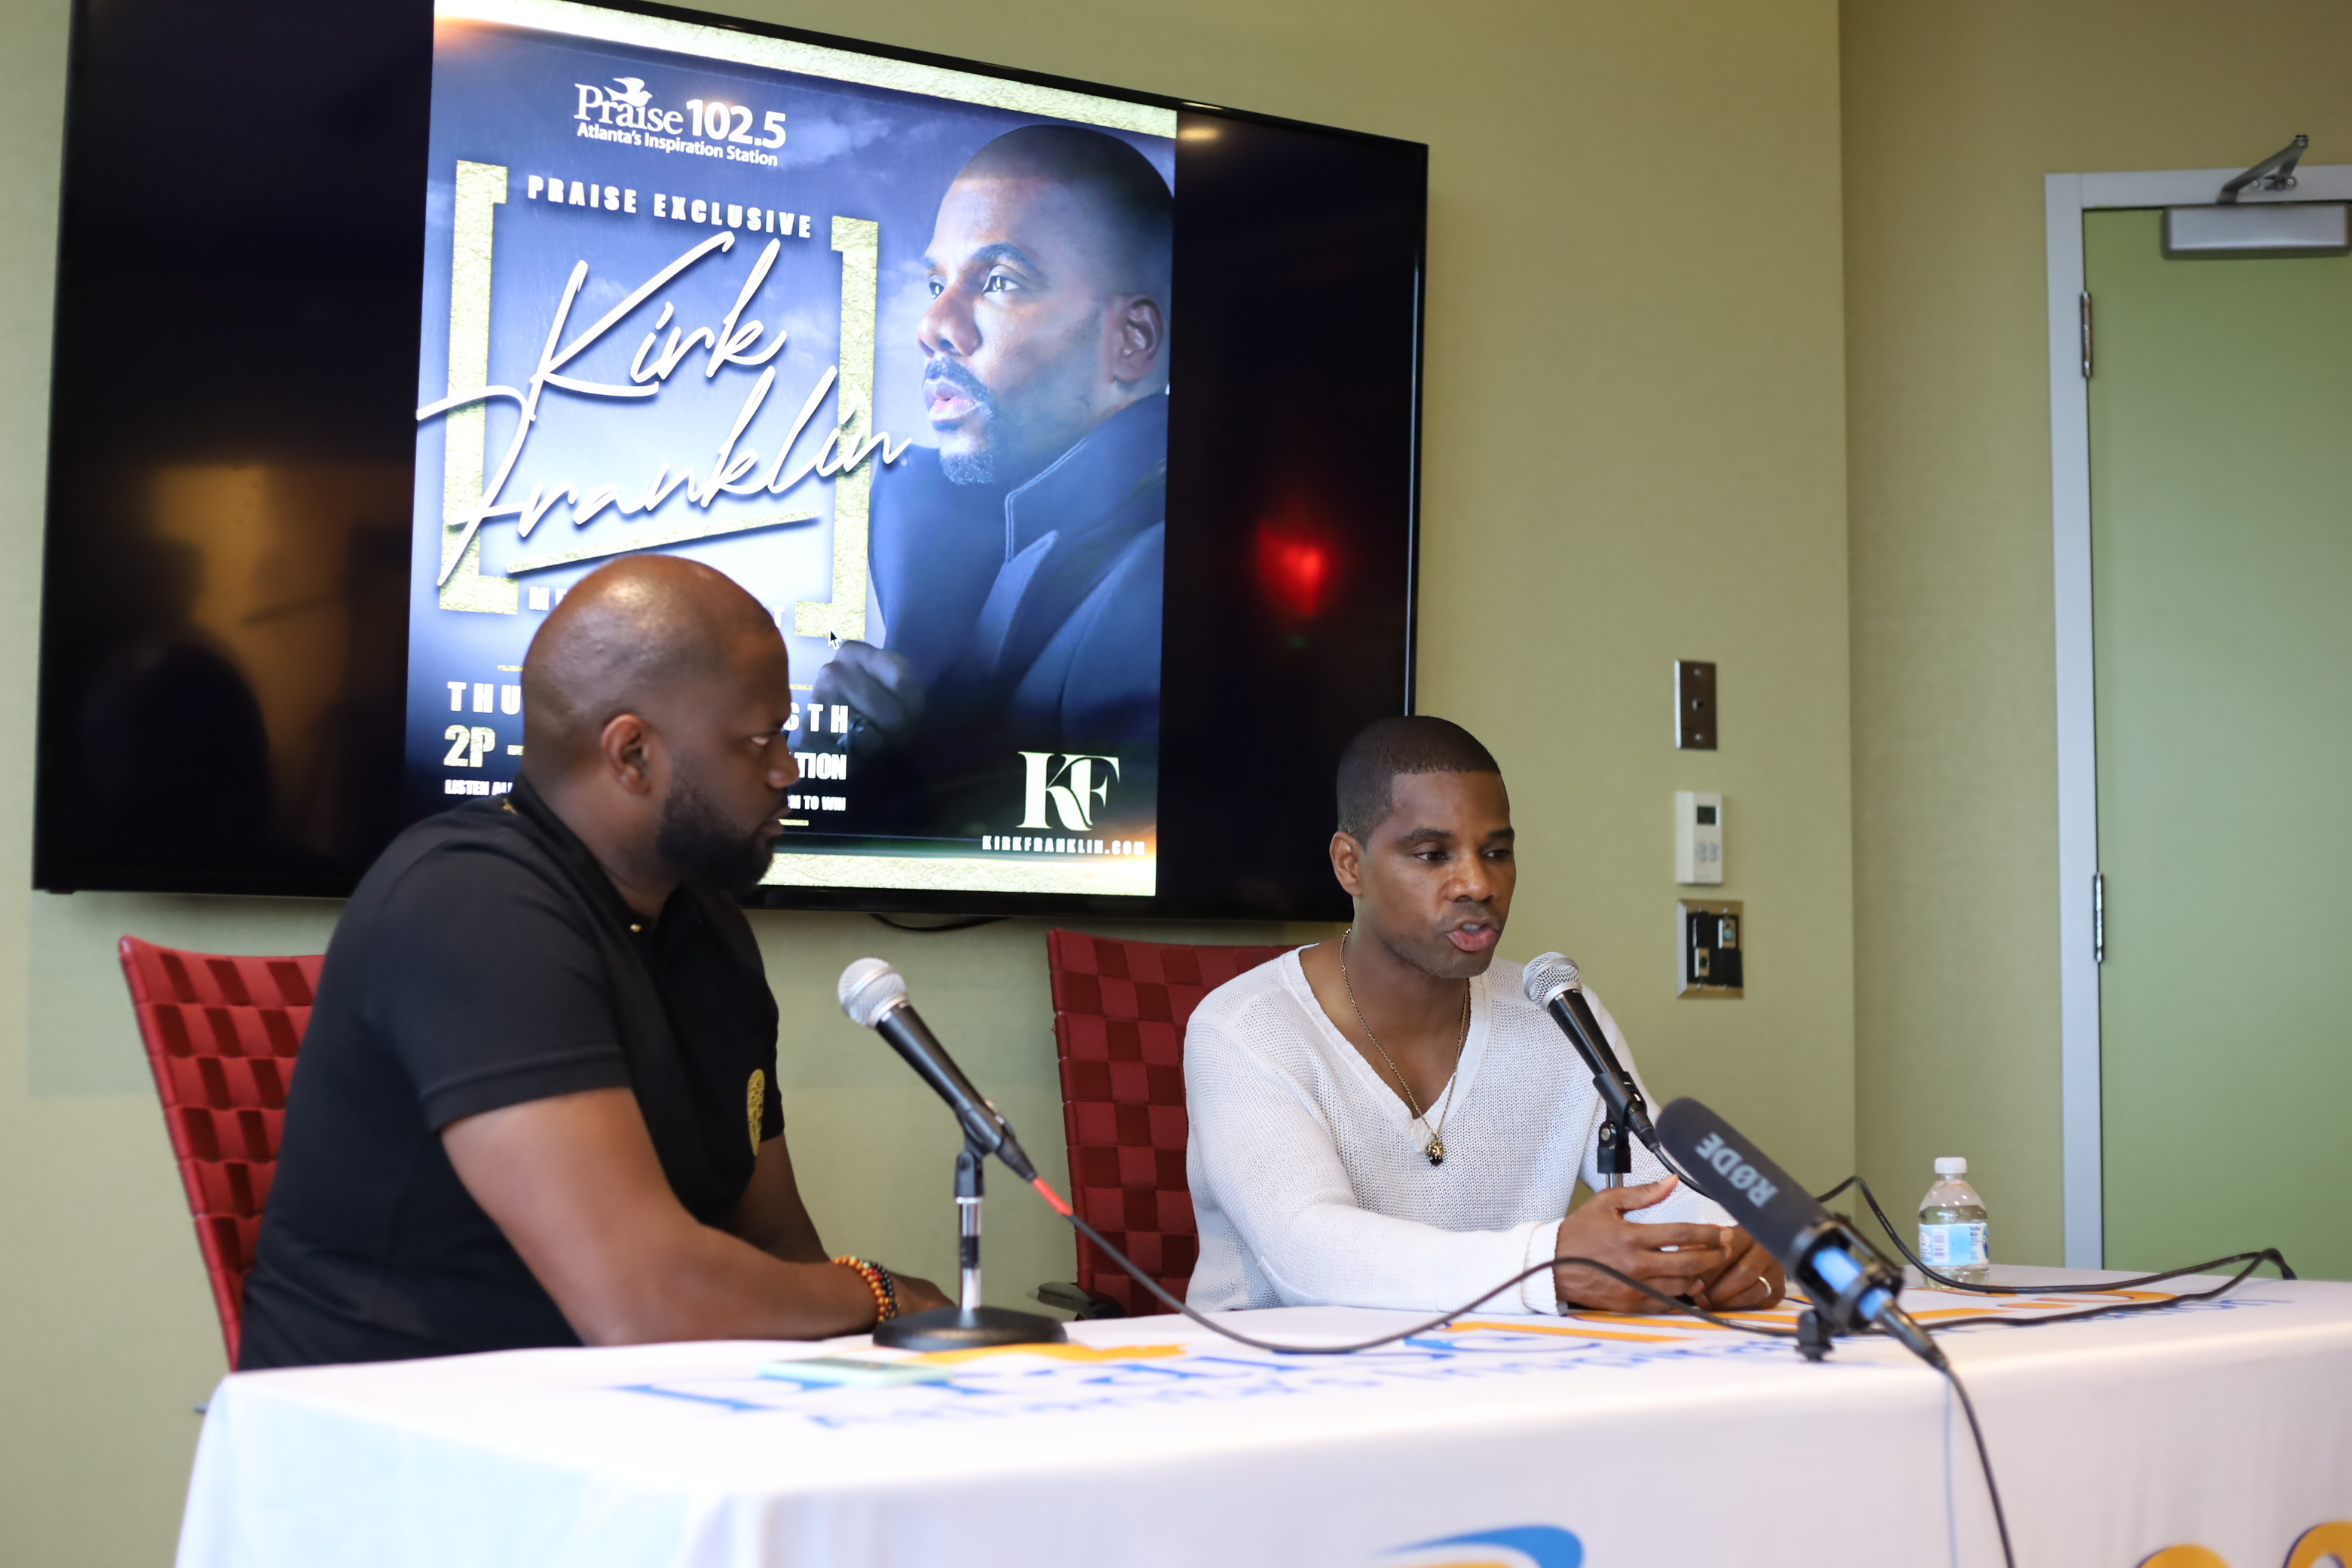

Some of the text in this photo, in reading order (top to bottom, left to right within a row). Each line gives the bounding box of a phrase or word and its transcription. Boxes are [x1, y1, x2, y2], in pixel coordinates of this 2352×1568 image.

[573, 83, 787, 149] Praise 102.5
[577, 121, 778, 167] Atlanta's Inspiration Station
[527, 175, 811, 238] PRAISE EXCLUSIVE
[529, 231, 787, 421] Kirk
[416, 366, 912, 586] Franklin
[447, 681, 522, 715] THU
[443, 724, 496, 767] 2P
[793, 752, 847, 780] TION
[444, 779, 490, 796] LISTEN
[803, 795, 819, 810] TO
[822, 796, 847, 811] WIN
[982, 835, 1146, 856] KIRKFRANKLIN.COM
